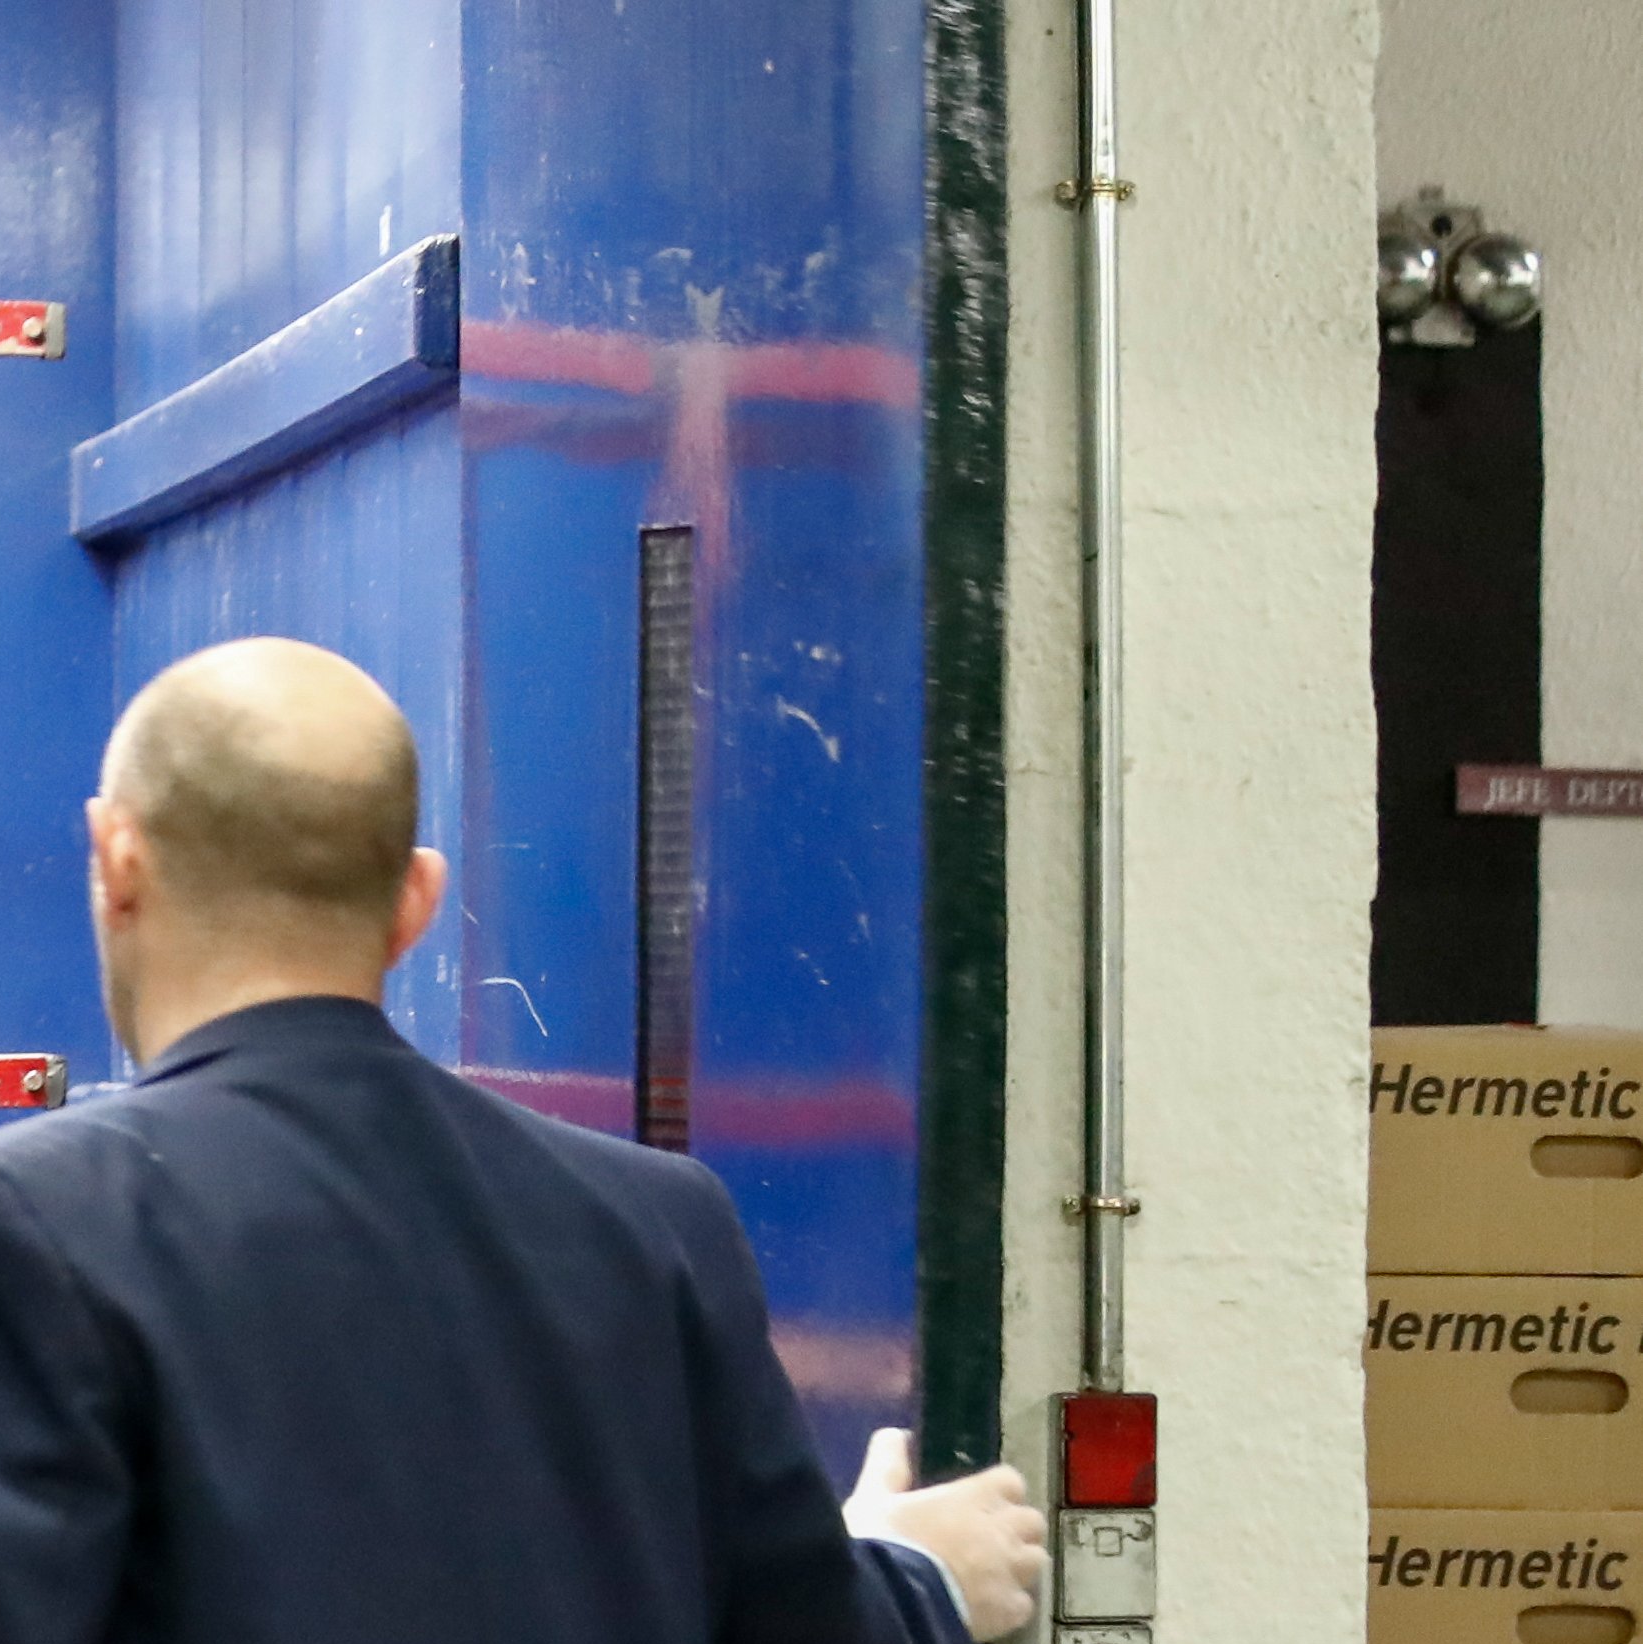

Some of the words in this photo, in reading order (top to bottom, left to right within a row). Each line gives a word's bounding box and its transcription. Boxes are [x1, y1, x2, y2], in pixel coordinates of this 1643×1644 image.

[1483, 776, 1551, 811] JEFE
[1568, 777, 1643, 806] DEPT
[1369, 1062, 1641, 1119] Hermetic
